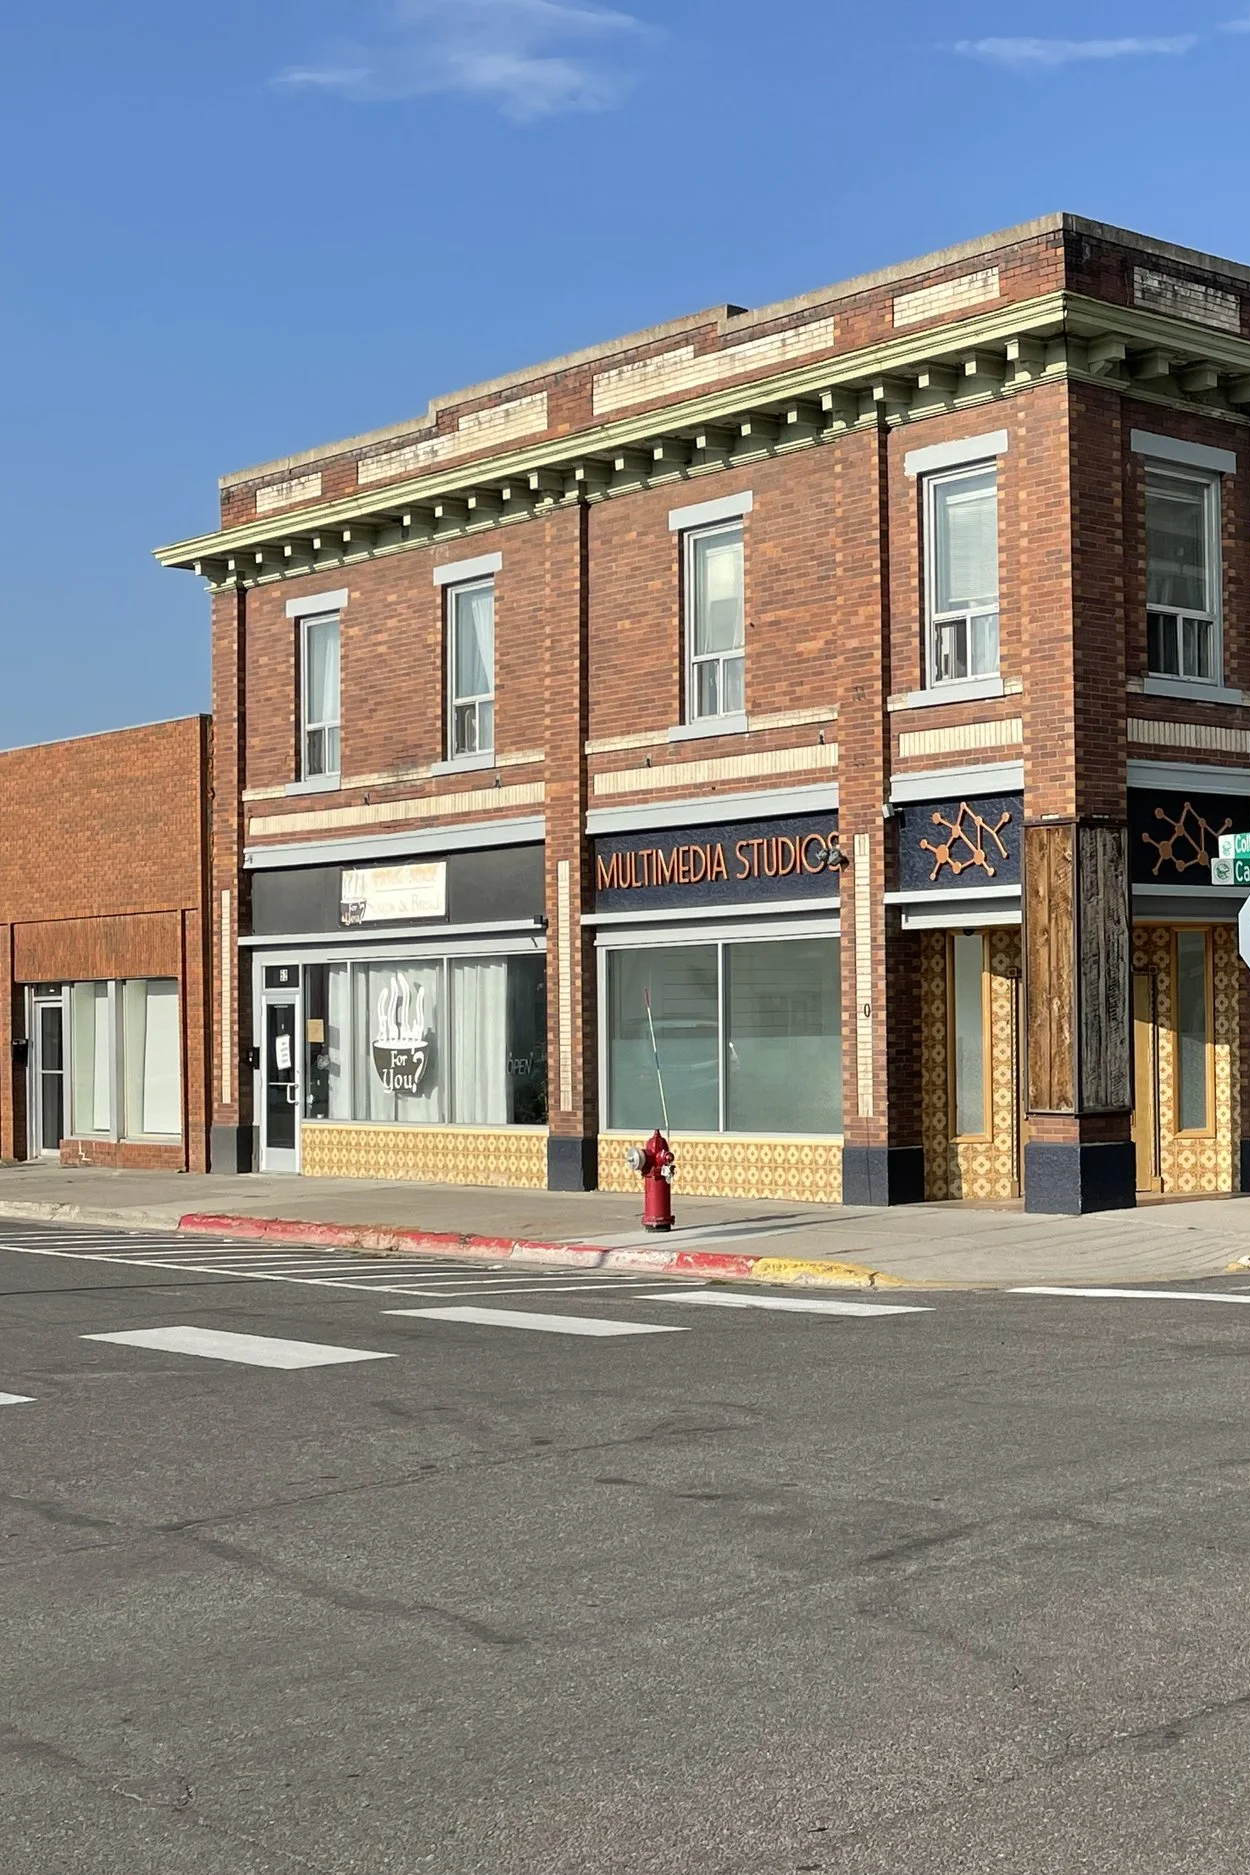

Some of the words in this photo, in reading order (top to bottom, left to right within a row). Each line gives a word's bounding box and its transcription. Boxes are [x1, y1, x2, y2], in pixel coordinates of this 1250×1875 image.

[598, 843, 728, 890] MULTIMEDIA
[390, 1050, 408, 1067] For
[507, 1058, 532, 1075] OPEN
